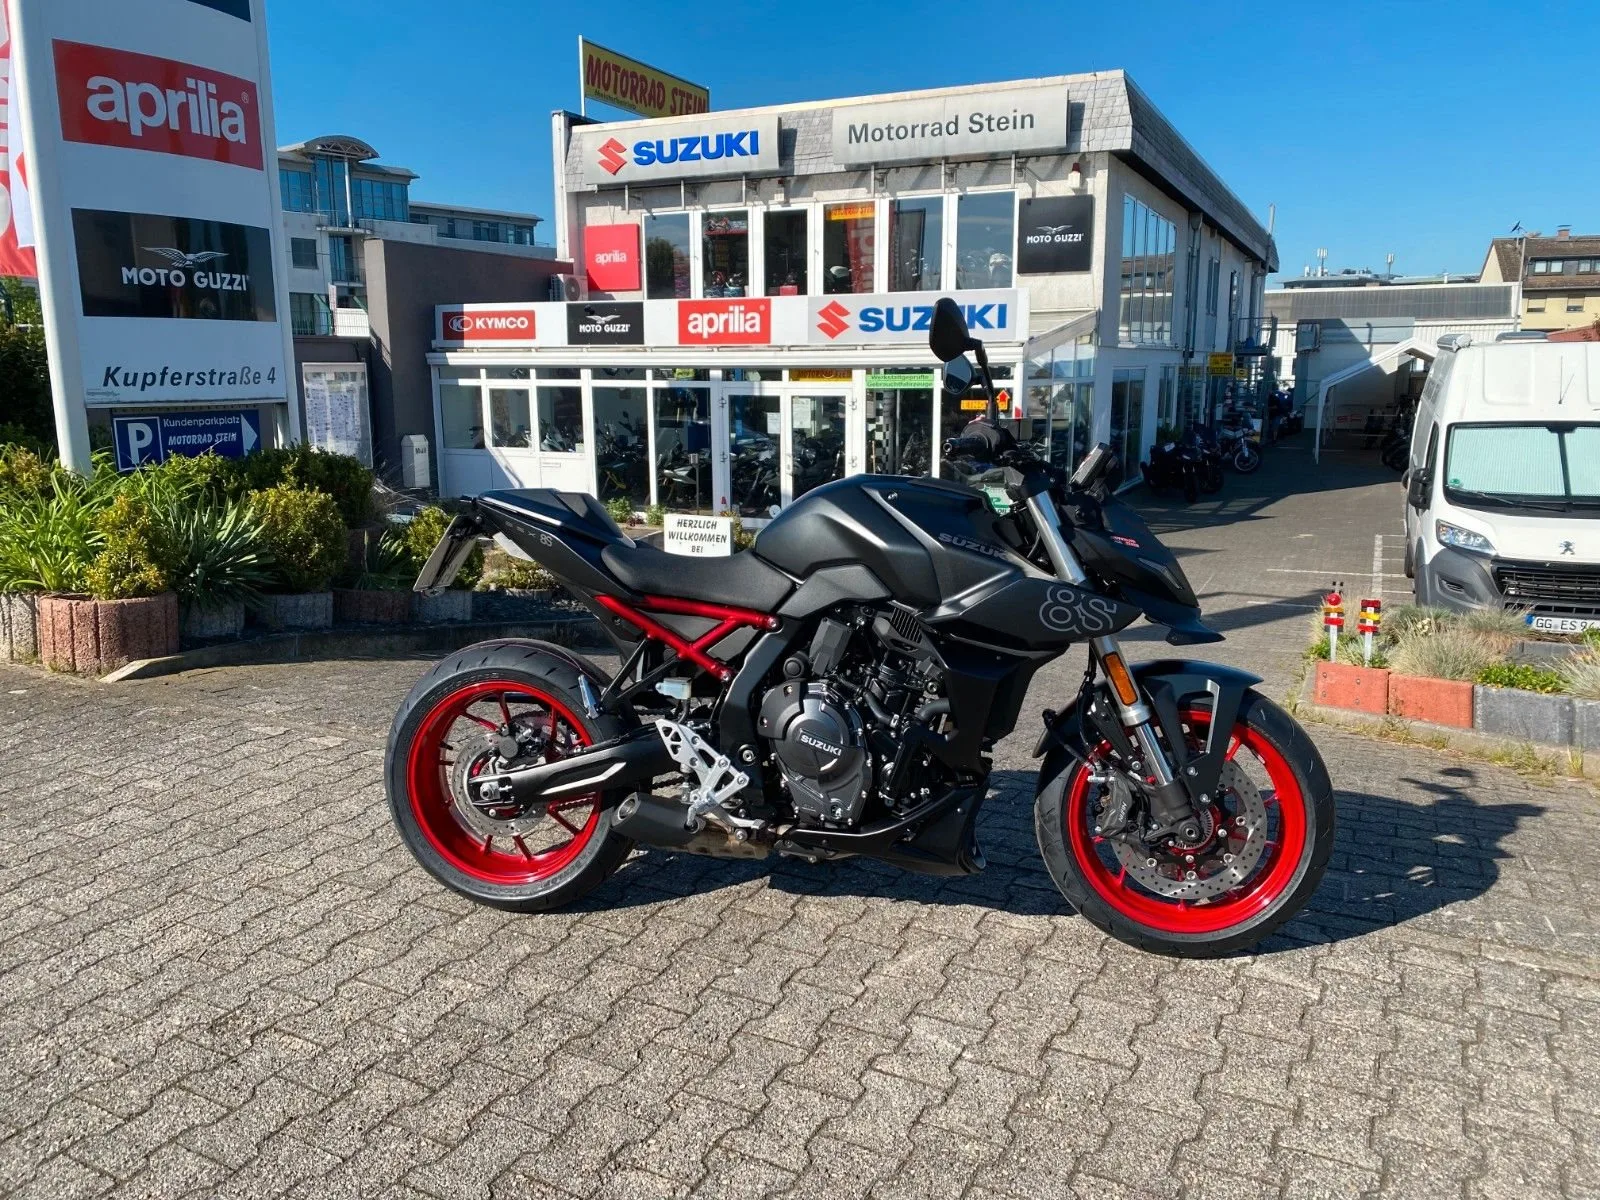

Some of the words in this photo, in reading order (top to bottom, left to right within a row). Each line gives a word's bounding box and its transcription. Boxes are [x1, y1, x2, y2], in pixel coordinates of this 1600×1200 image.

[586, 54, 665, 110] MOTORRAD
[670, 86, 706, 116] STEIN
[87, 75, 246, 144] aprilia
[848, 115, 959, 144] Motorrad
[968, 109, 1034, 134] Stein
[633, 131, 759, 166] SUZUKI
[1026, 235, 1052, 243] MOTO
[1054, 233, 1082, 242] GUZZI
[595, 250, 627, 265] aprilia
[122, 266, 186, 287] MOTO
[193, 273, 247, 291] GUZZI
[475, 316, 529, 329] KYMCO
[688, 305, 760, 339] aprilia
[858, 303, 1007, 332] SUZKI
[579, 324, 602, 333] MOTO
[604, 323, 629, 332] GUZZI
[102, 366, 262, 391] Kupferstraße
[267, 366, 276, 385] 4
[163, 415, 240, 428] Kundenparkplatz
[127, 422, 153, 465] P
[168, 433, 212, 445] MOTORRAD
[215, 432, 237, 443] STEIN
[677, 518, 717, 530] HERZLICH
[668, 530, 727, 543] WILLKOMMEN
[691, 545, 704, 553] BEI
[1536, 618, 1553, 629] GG
[1560, 620, 1577, 631] ES
[801, 734, 842, 756] SUZUKI
